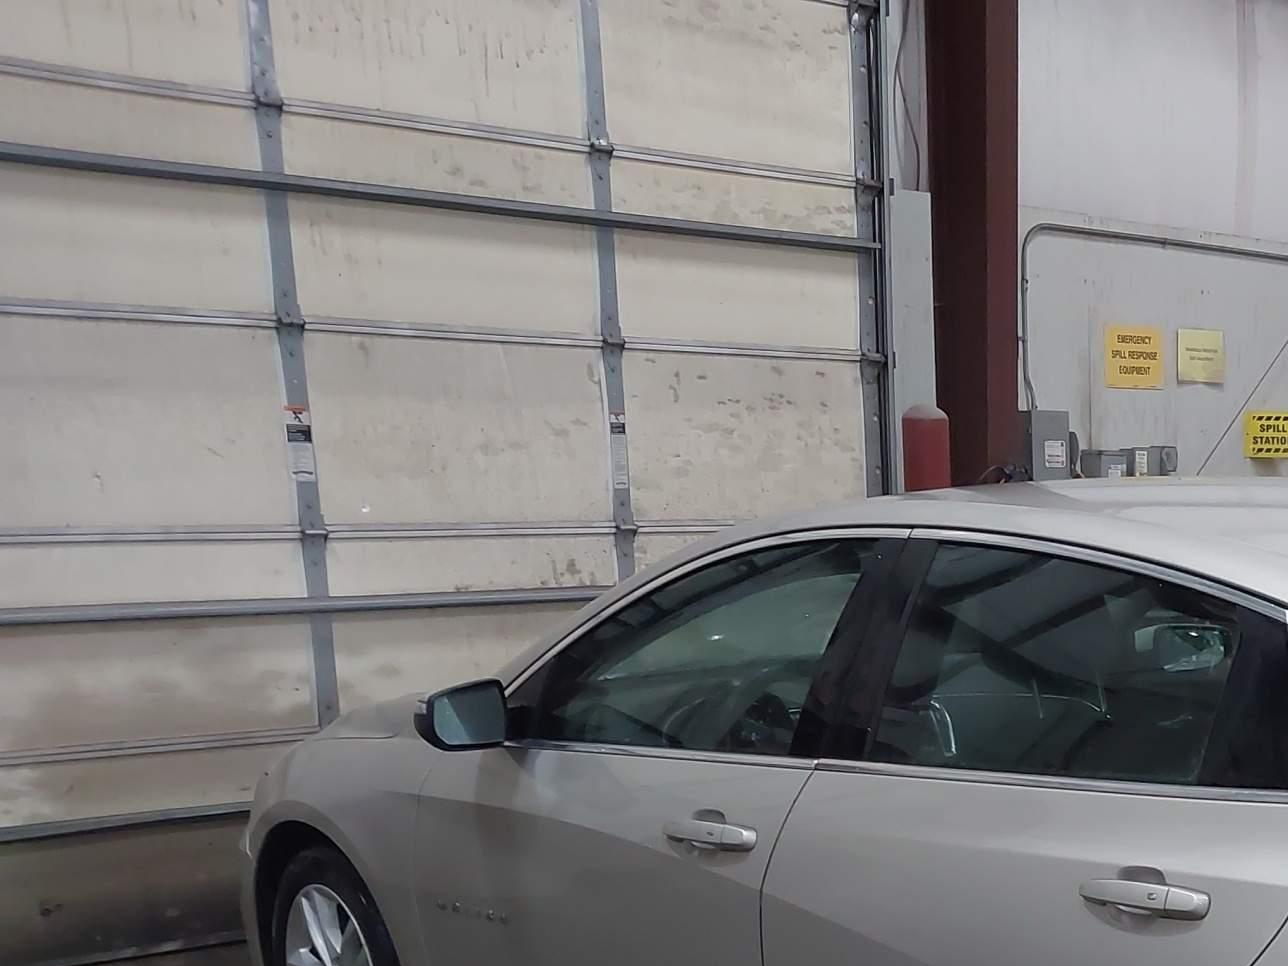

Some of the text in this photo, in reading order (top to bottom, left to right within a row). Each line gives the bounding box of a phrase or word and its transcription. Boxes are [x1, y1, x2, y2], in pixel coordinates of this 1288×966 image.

[1116, 334, 1152, 345] EMERGENCY
[1111, 349, 1158, 361] SPILL RESPONSE
[1118, 365, 1151, 376] EQUIPMENT
[1259, 423, 1288, 433] SPILL
